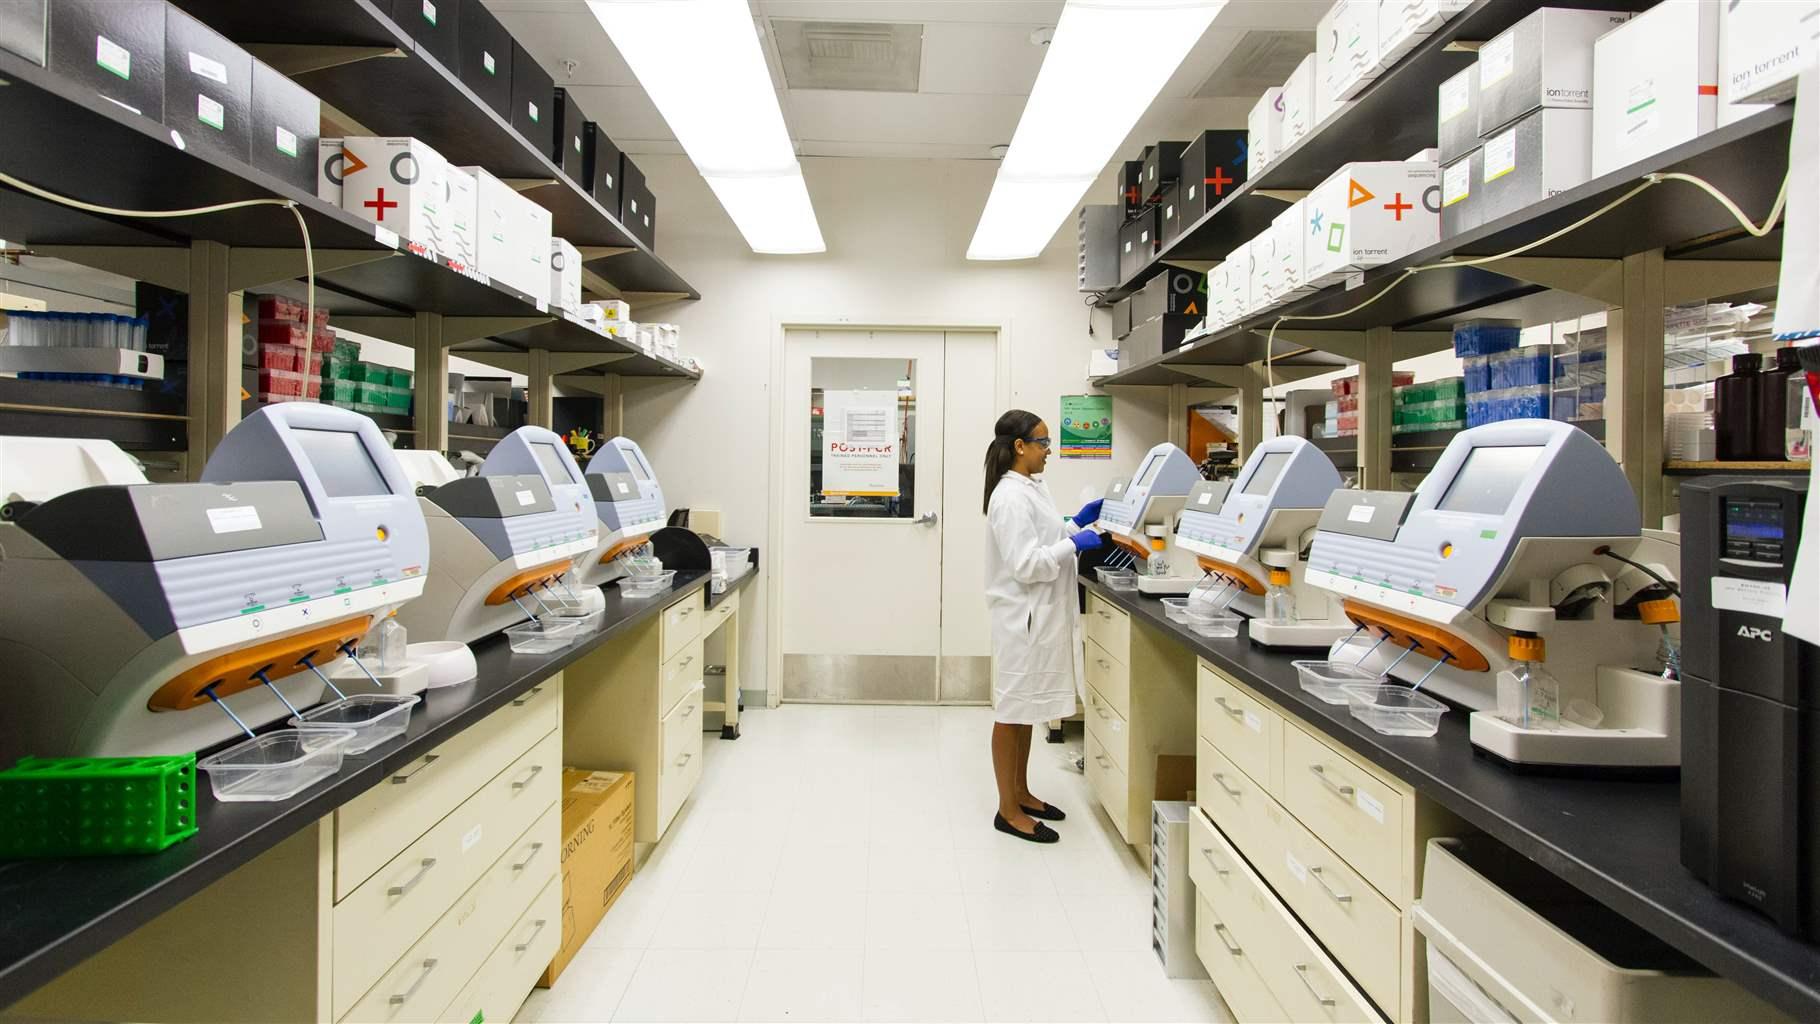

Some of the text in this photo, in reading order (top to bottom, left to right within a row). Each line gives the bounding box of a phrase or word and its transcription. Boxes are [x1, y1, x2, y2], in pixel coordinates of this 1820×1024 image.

[1733, 46, 1799, 84] ion torrent
[1737, 625, 1772, 642] APC
[560, 818, 595, 864] ORNING
